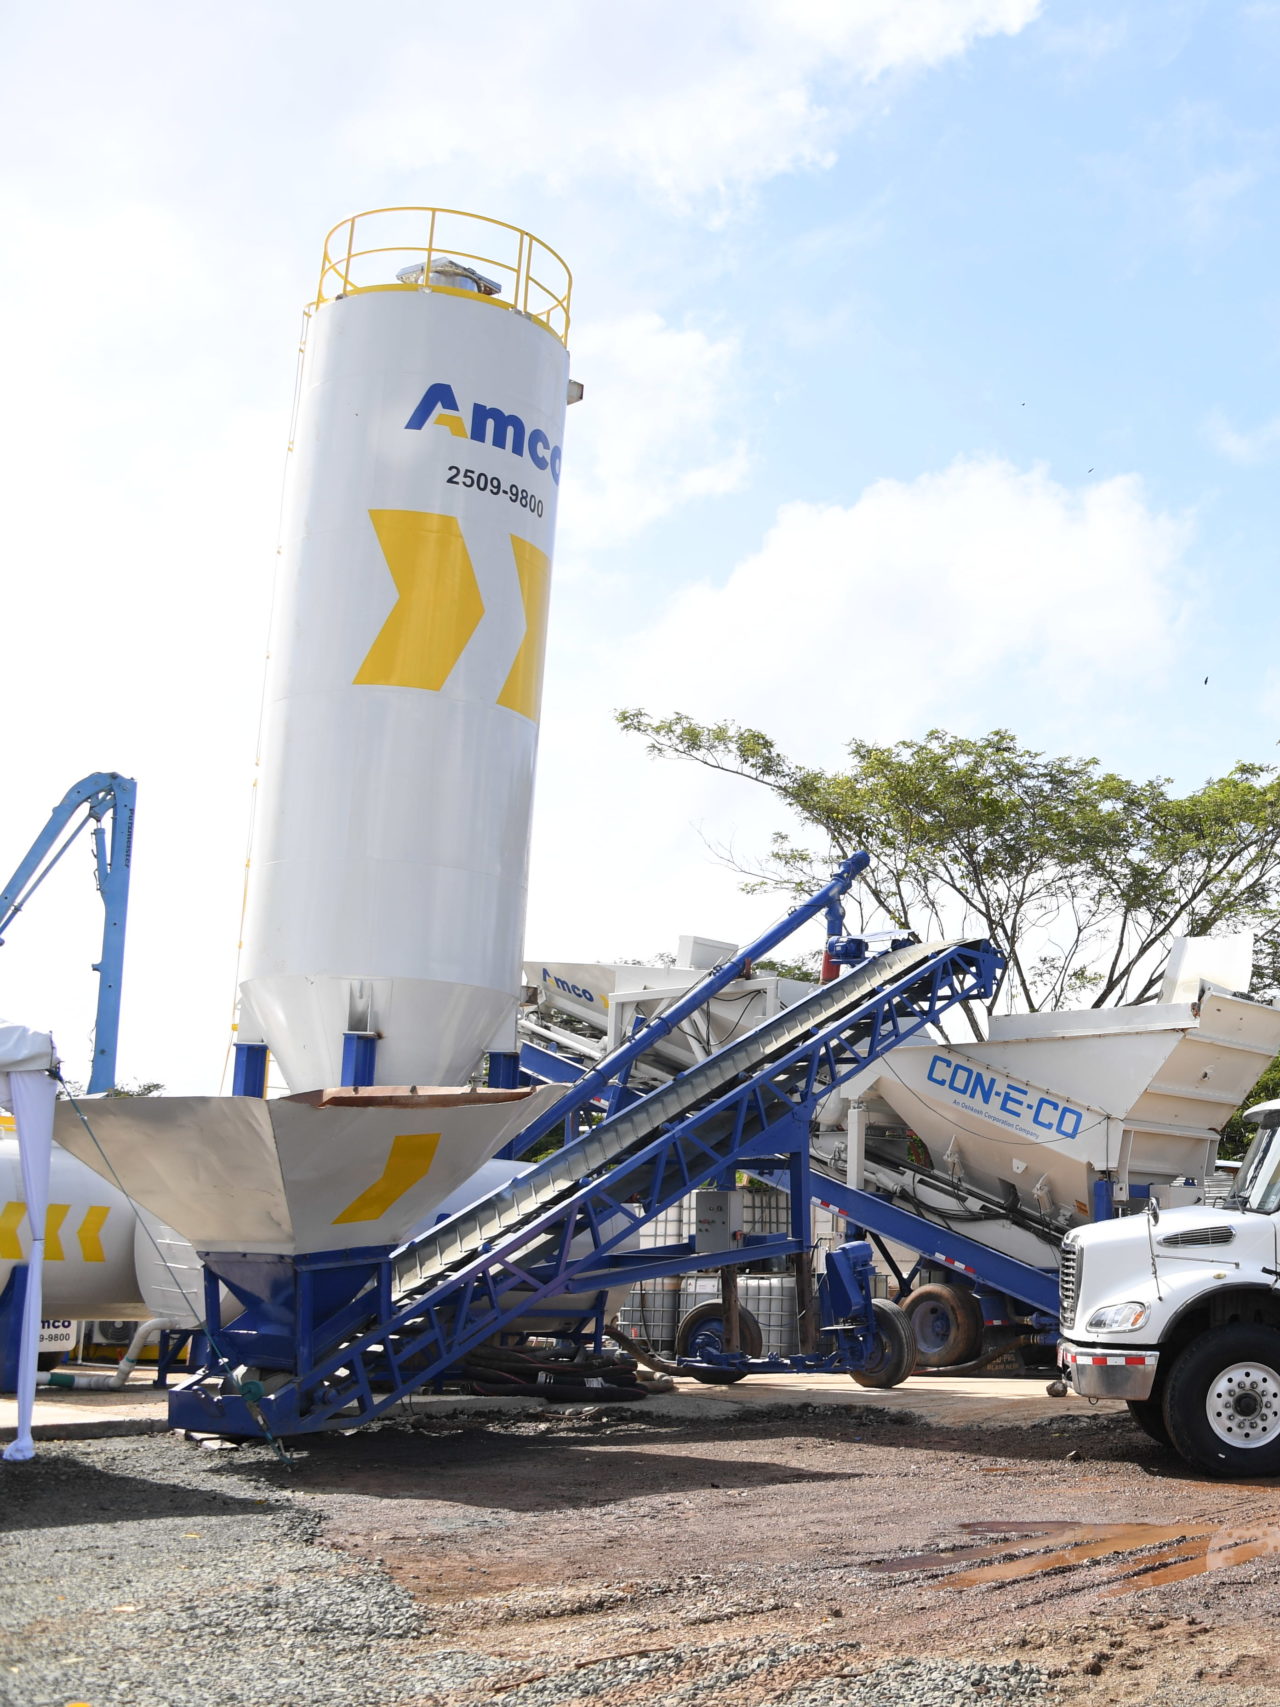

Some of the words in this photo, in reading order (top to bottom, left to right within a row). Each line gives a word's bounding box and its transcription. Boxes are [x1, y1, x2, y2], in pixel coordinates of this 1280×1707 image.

[404, 383, 562, 486] Amco
[446, 465, 544, 518] 2509-9800
[542, 967, 594, 1002] Amco
[927, 1055, 1083, 1139] CON-E-CO
[961, 1102, 984, 1116] Oshkosh
[984, 1111, 1014, 1129] Corporation
[1015, 1124, 1040, 1139] Company
[40, 1333, 71, 1342] 9-9800
[41, 1320, 72, 1330] mco
